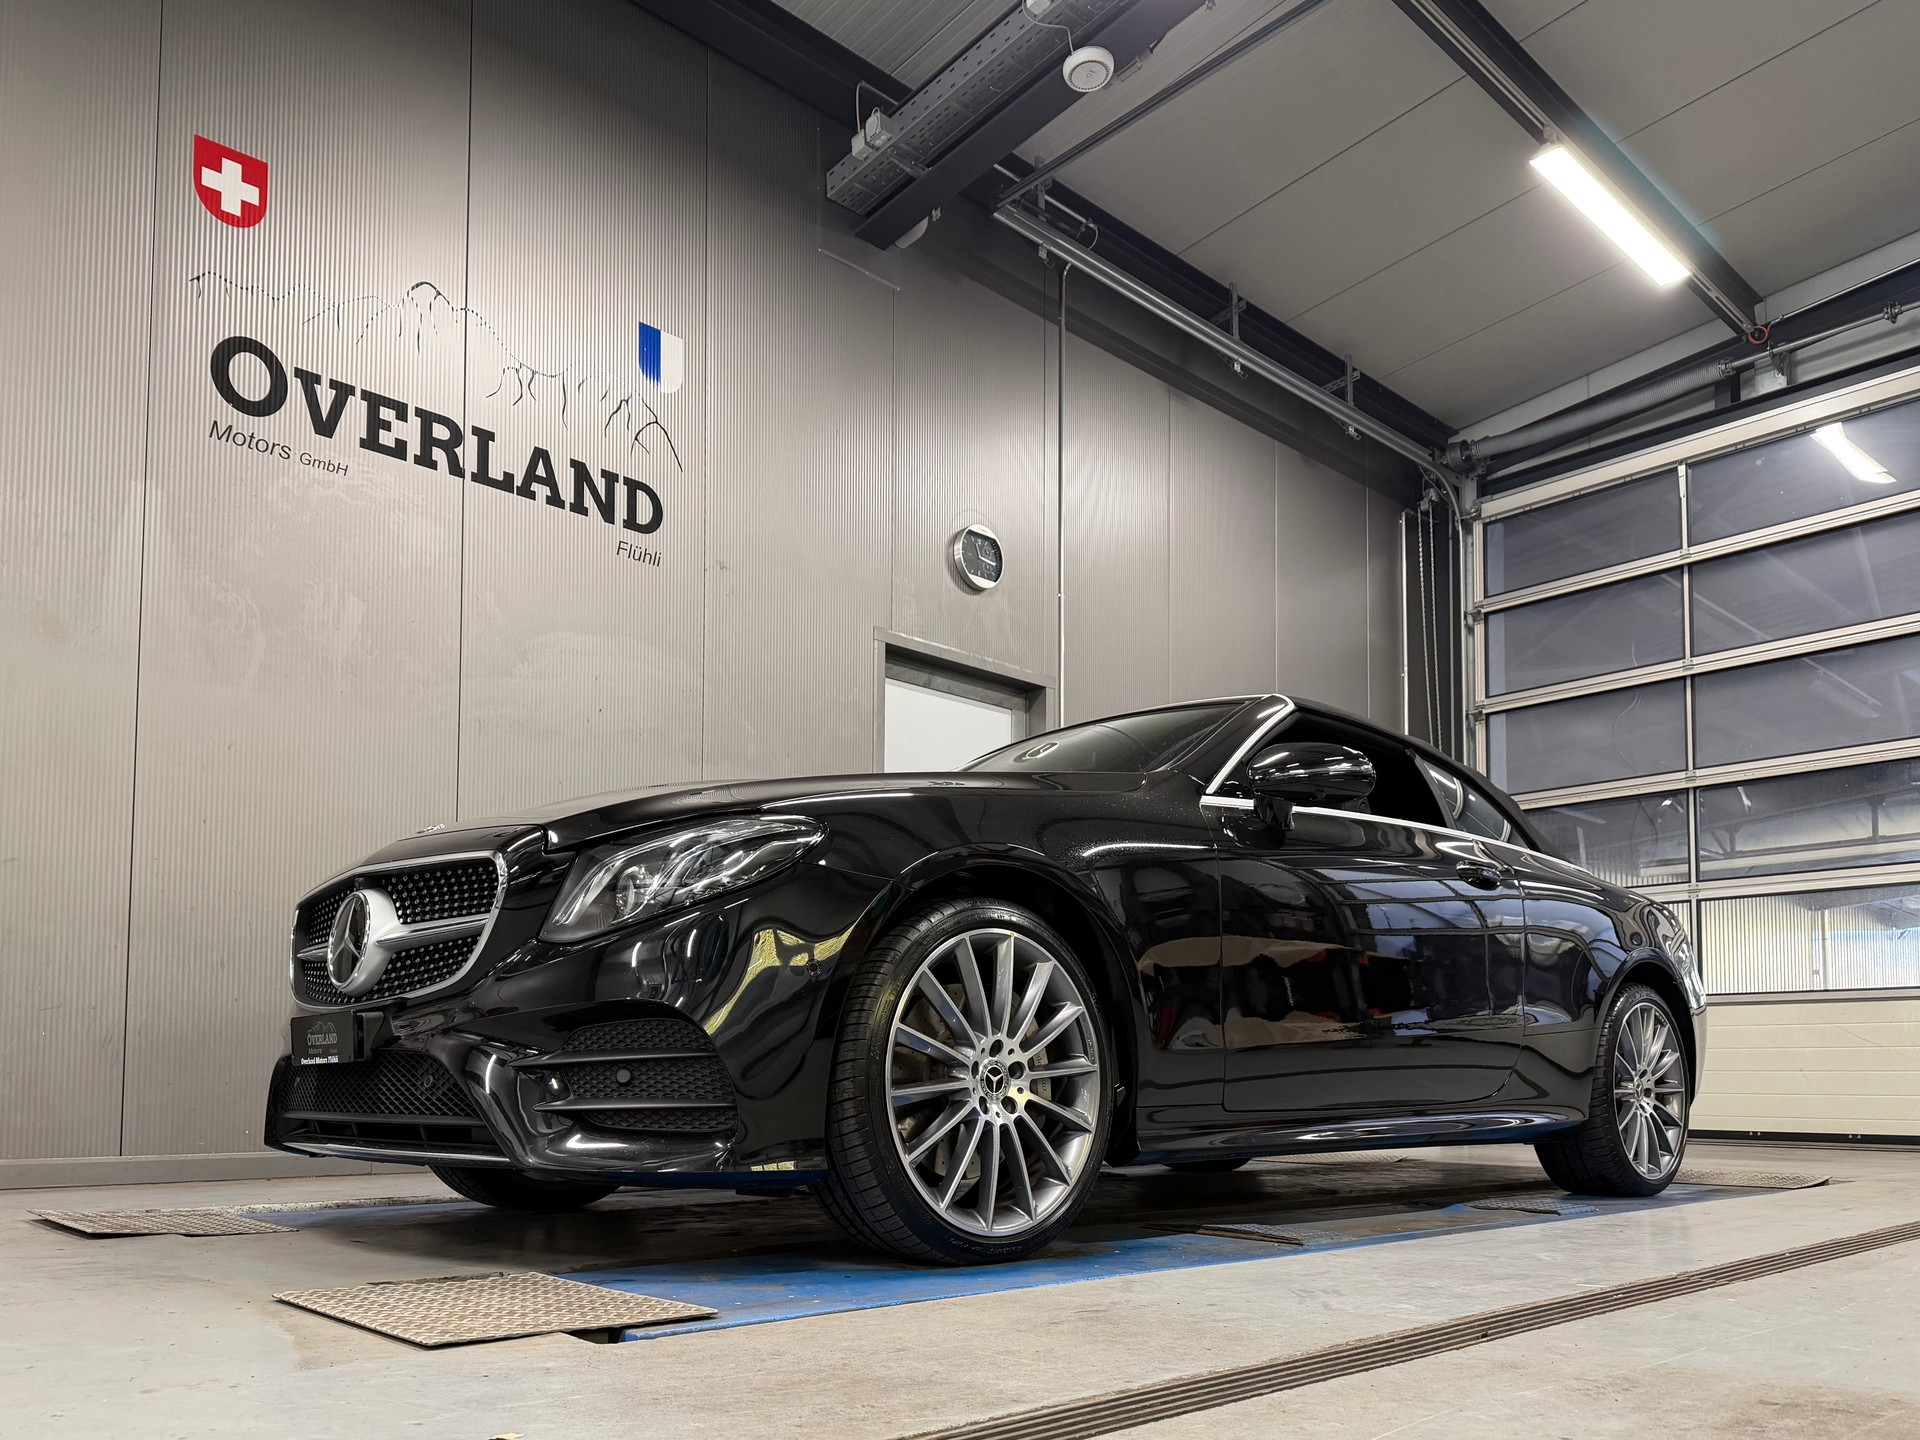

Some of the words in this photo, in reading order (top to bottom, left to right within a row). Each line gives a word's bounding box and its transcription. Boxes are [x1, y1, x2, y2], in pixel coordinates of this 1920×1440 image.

[209, 420, 292, 460] Motors
[299, 452, 349, 476] GmbH
[210, 336, 664, 535] OVERLAND
[616, 540, 662, 567] Flühli
[307, 1033, 338, 1046] OVERLAND
